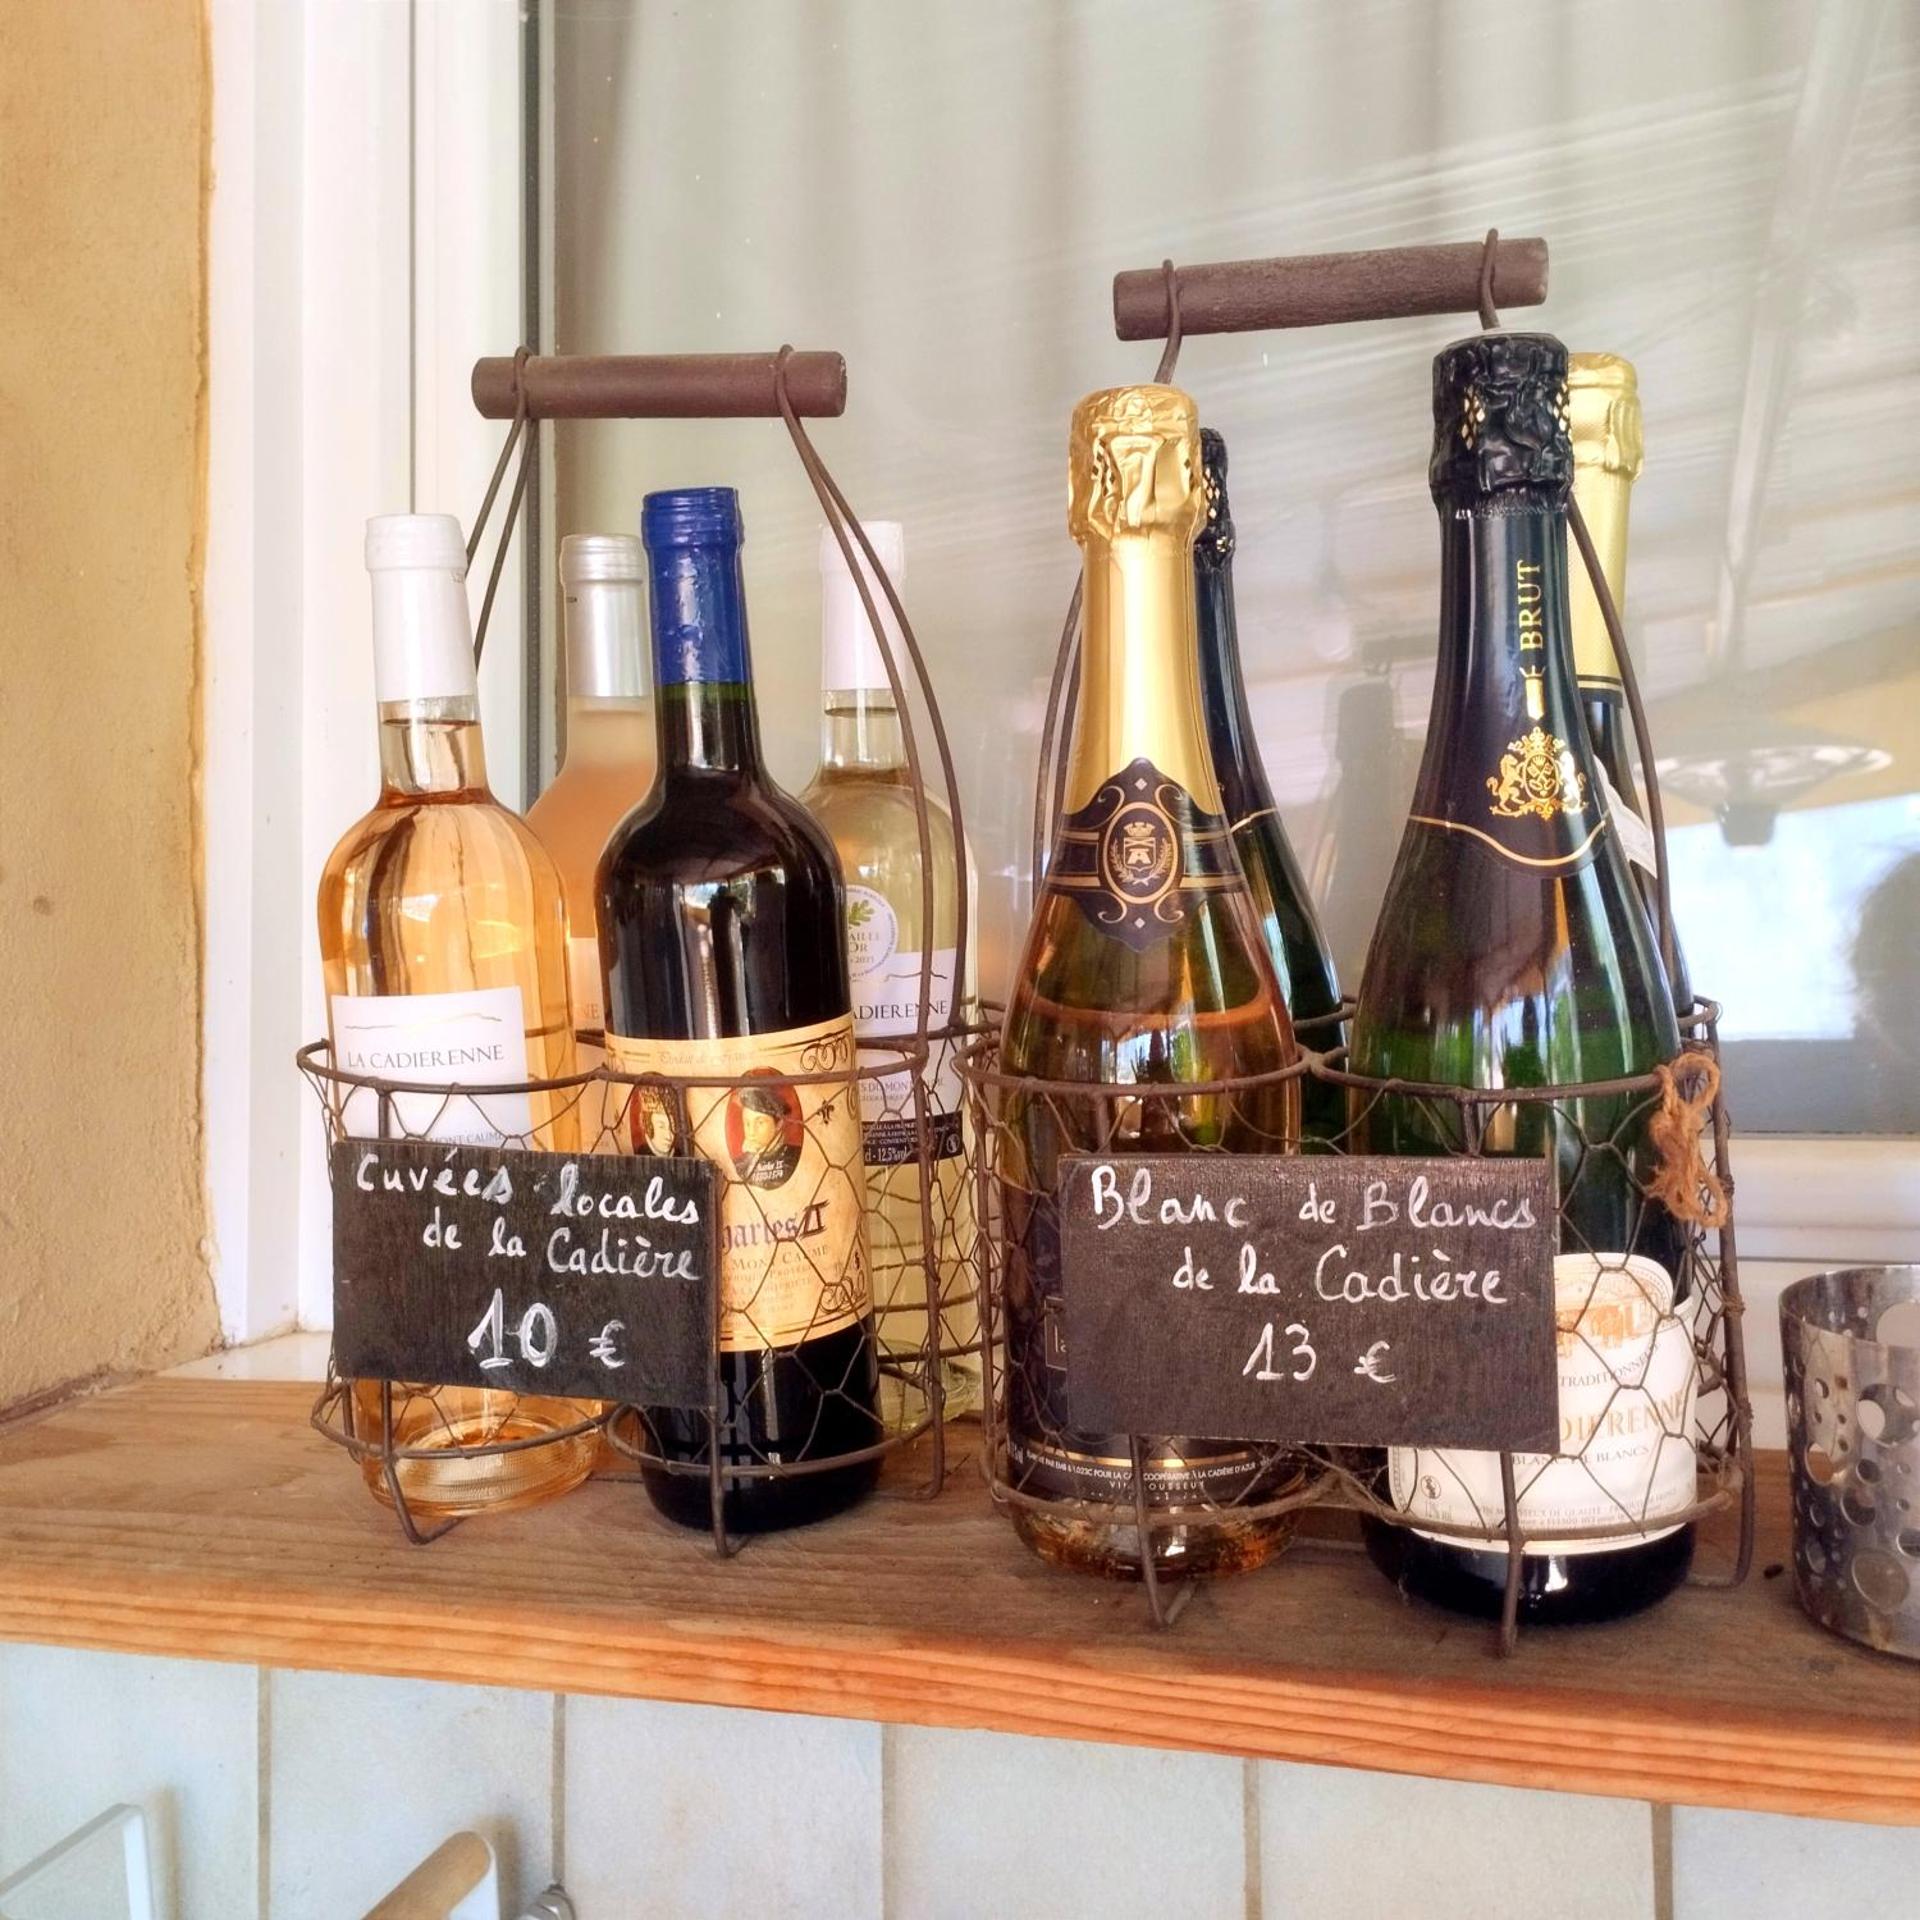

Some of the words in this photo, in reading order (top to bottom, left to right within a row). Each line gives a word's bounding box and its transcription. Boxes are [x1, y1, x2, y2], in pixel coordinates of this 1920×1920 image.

[1517, 560, 1543, 650] BRUT
[347, 1051, 365, 1069] LA
[369, 1045, 505, 1069] CADIERENNE
[356, 1148, 514, 1204] Cuvées
[550, 1160, 700, 1225] locales
[1091, 1165, 1249, 1231] Blanc
[1299, 1182, 1337, 1224] de
[1357, 1175, 1537, 1231] Blancs
[422, 1205, 463, 1250] de
[488, 1216, 527, 1257] la
[547, 1227, 701, 1281] Cadière
[1172, 1245, 1214, 1290] de
[1237, 1242, 1281, 1295] la
[1315, 1244, 1508, 1303] Cadière
[467, 1287, 557, 1368] 10
[588, 1319, 626, 1369] €
[1242, 1322, 1318, 1381] 13
[1353, 1340, 1397, 1384] €
[1148, 1481, 1205, 1491] OUSSEUX
[1596, 1447, 1649, 1463] BLANCS
